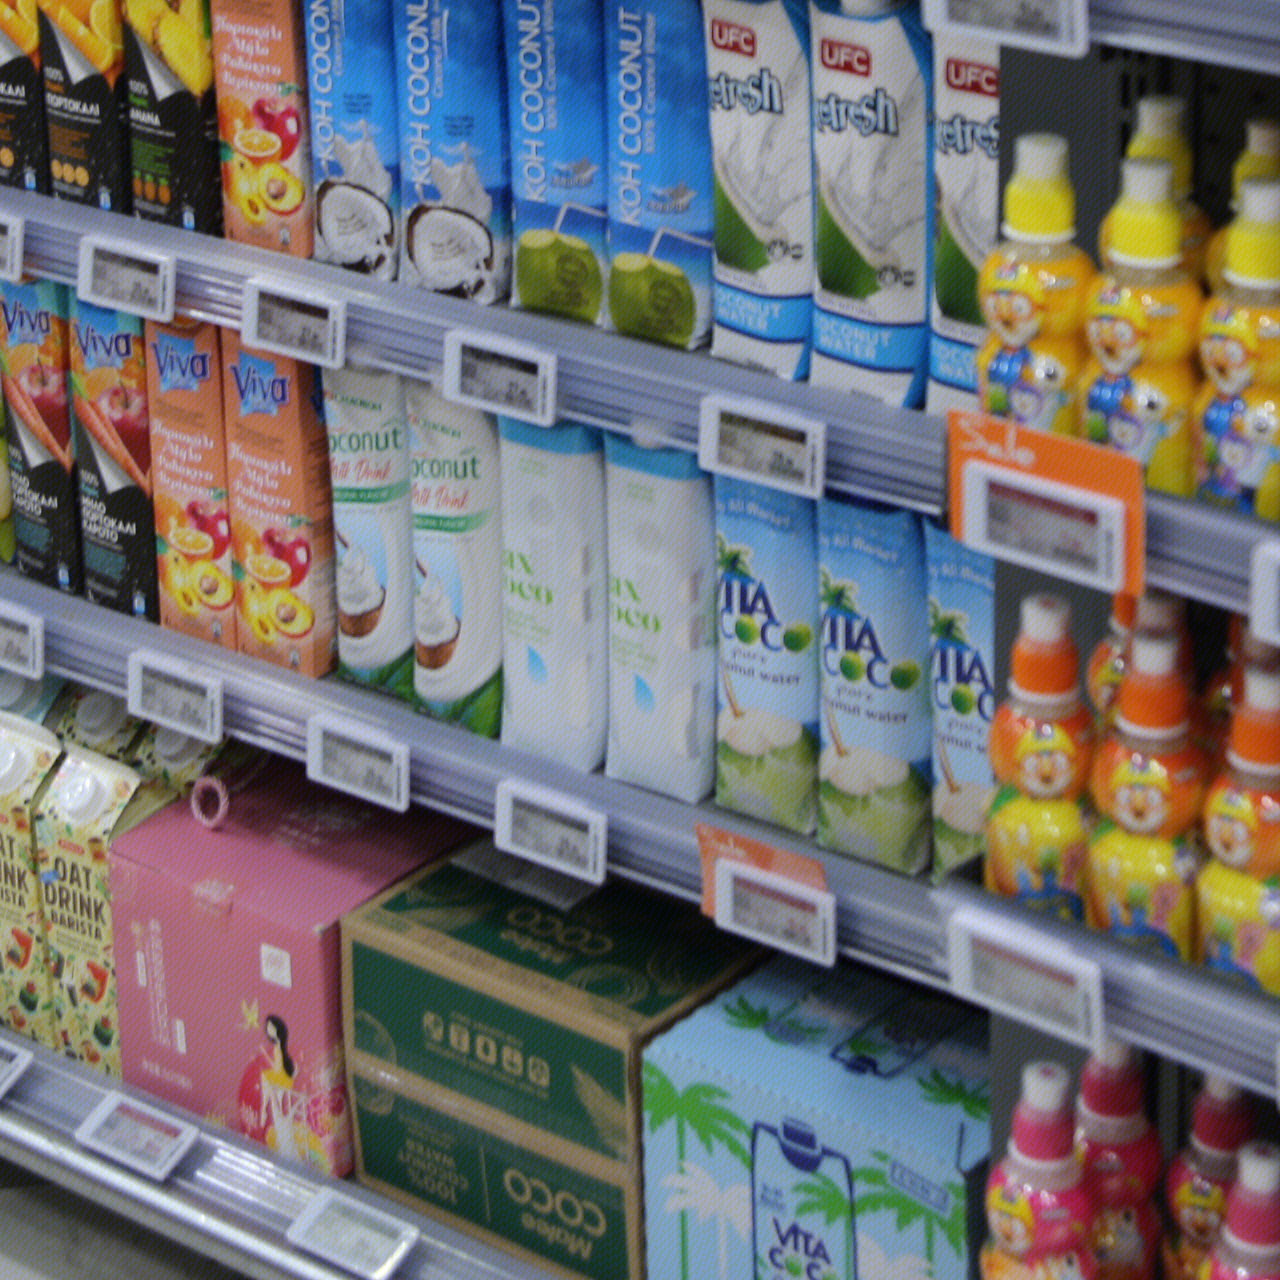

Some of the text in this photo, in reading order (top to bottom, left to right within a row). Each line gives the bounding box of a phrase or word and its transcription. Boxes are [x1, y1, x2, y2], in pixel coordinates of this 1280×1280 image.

[713, 23, 754, 55] UFC
[821, 41, 869, 75] UFC
[709, 67, 784, 115] efresh
[947, 60, 1000, 95] UFC
[314, 94, 337, 173] KOH
[618, 7, 644, 227] KOH COCONUT
[408, 115, 432, 190] KOH
[523, 133, 548, 203] KOH
[1, 303, 52, 337] Viva
[74, 325, 133, 363] Viva
[151, 342, 213, 381] Viva
[230, 363, 290, 404] Viva
[328, 427, 404, 453] oconut
[958, 416, 1036, 466] Sale
[411, 455, 481, 481] oconut
[933, 677, 995, 721] COC
[53, 855, 93, 892] OAT
[44, 879, 106, 923] DRINK
[50, 908, 104, 941] BARISTA
[772, 1216, 831, 1265] VITA
